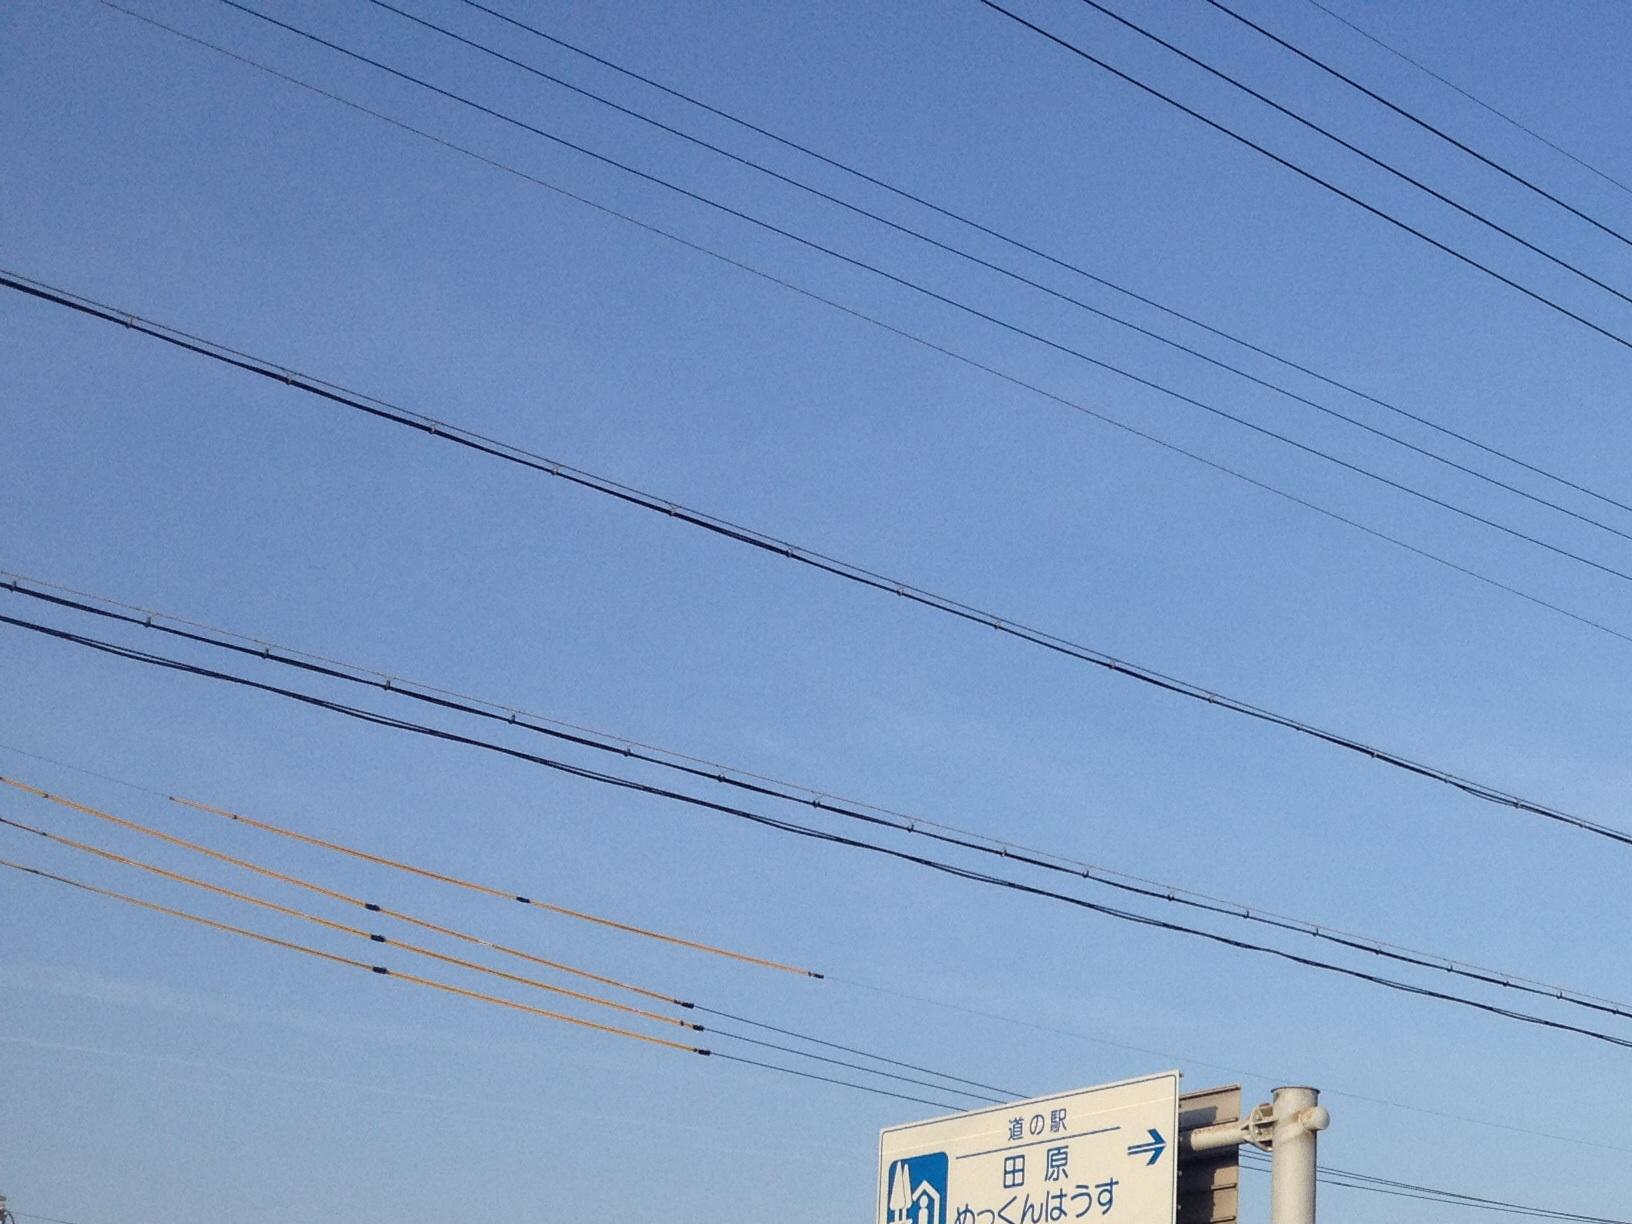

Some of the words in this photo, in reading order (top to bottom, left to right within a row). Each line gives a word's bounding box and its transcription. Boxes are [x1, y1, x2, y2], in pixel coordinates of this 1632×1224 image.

[1008, 1108, 1067, 1141] 道の駅
[1003, 1145, 1069, 1188] 田原
